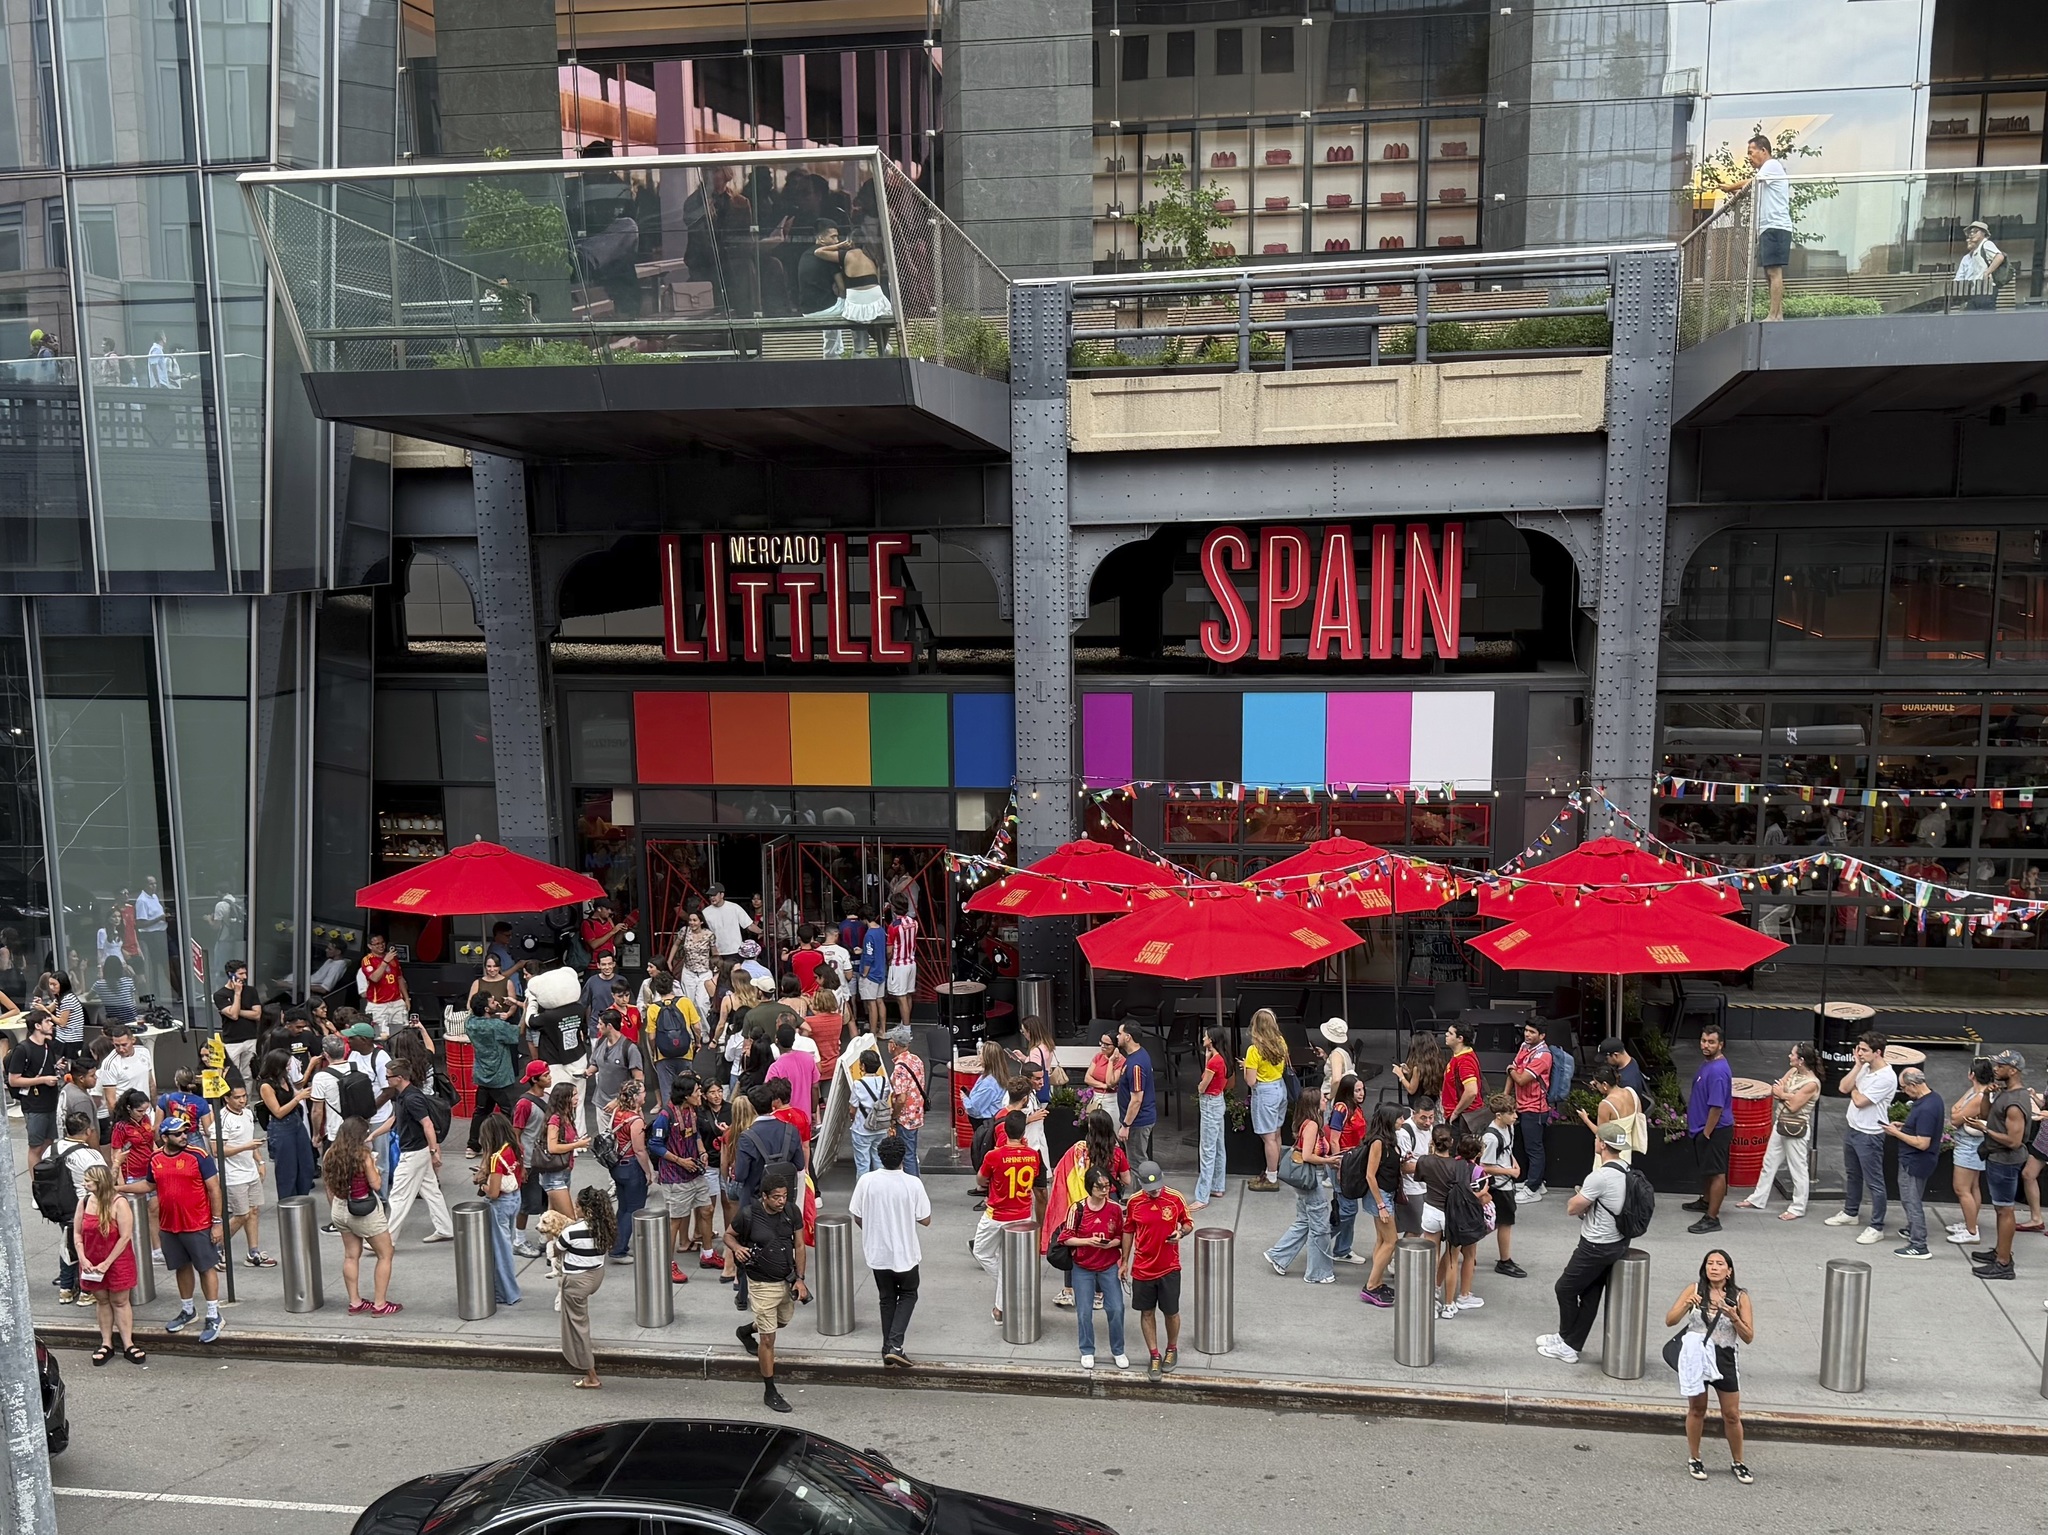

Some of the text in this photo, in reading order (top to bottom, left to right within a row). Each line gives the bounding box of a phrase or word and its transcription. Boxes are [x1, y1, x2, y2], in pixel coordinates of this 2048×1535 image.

[729, 535, 820, 565] MERCADO
[659, 522, 1464, 663] LITTLE SPAIN
[1355, 888, 1385, 900] LITTLE
[1361, 895, 1392, 909] SPAIN
[1141, 940, 1175, 954] LITTLE
[1645, 944, 1681, 955] LITTLE
[1133, 951, 1167, 965] SPAIN
[1652, 952, 1691, 964] SPAIN
[385, 973, 395, 985] 19
[1003, 1165, 1035, 1199] 19
